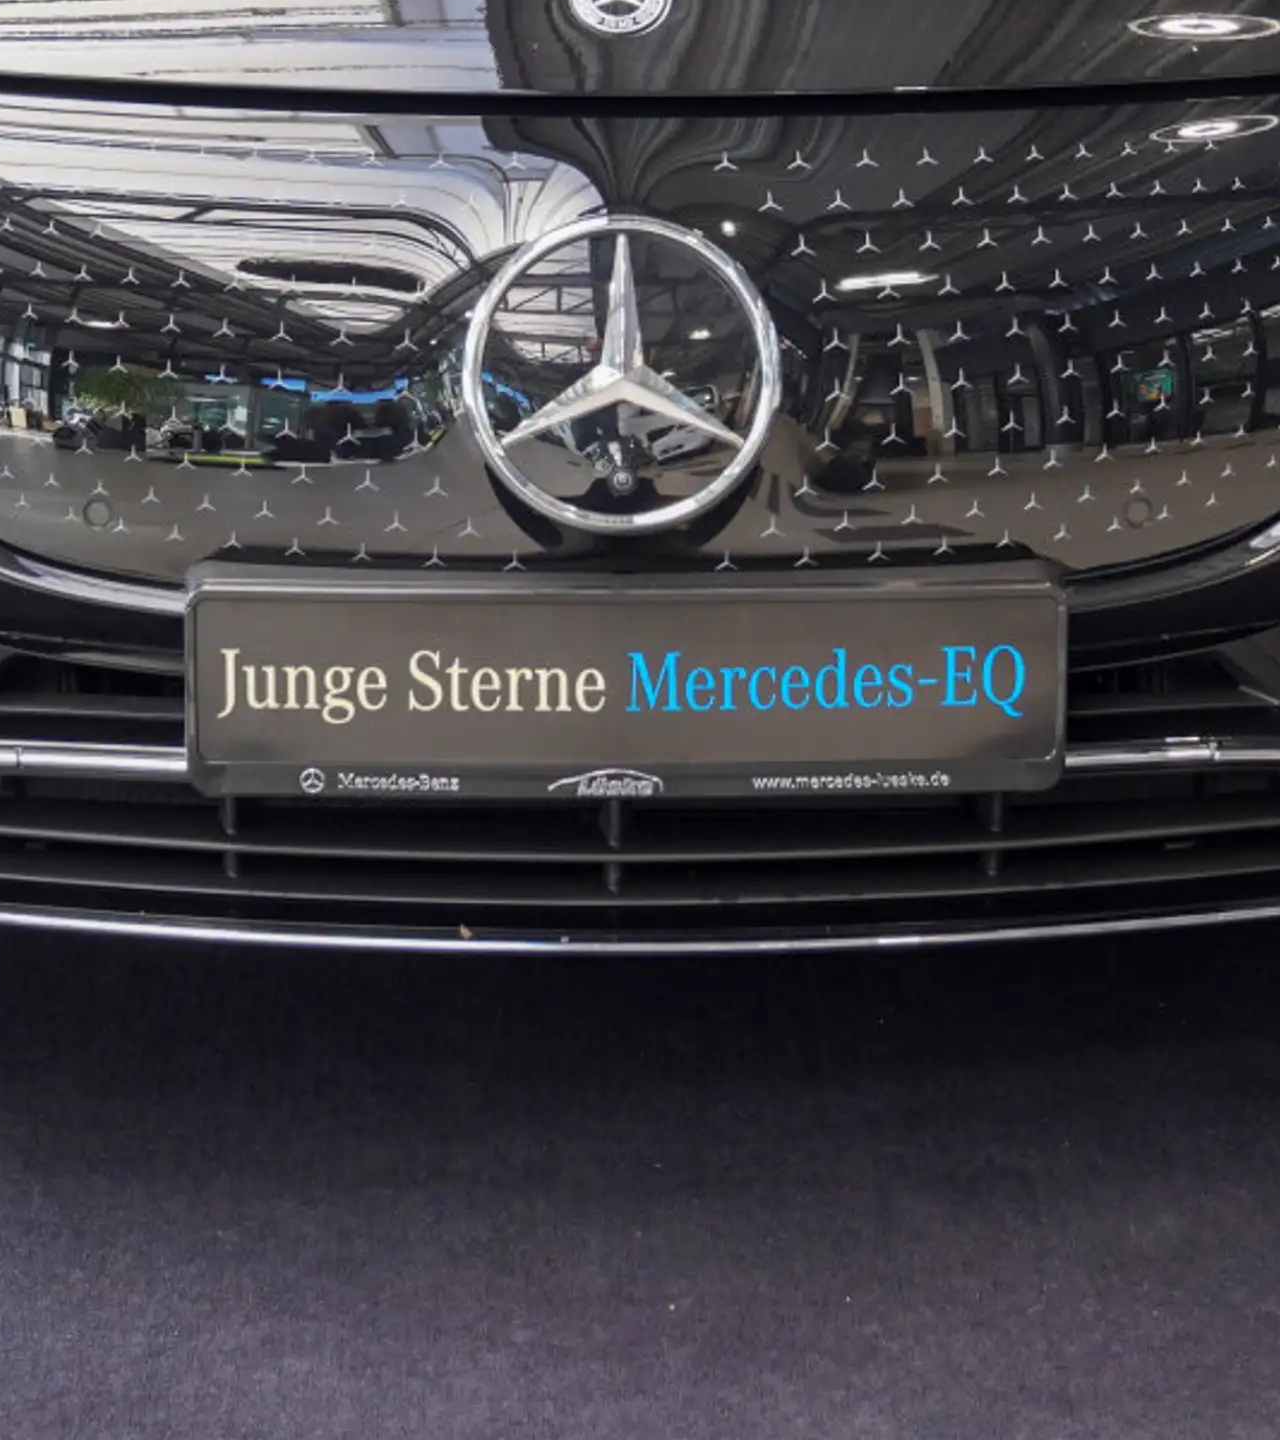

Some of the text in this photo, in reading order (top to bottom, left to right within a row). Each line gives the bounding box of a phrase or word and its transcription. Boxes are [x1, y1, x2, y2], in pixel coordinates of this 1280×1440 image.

[217, 644, 1026, 725] Junge Sterne Mercedes-EQ
[337, 772, 460, 791] Mercedes-Benz
